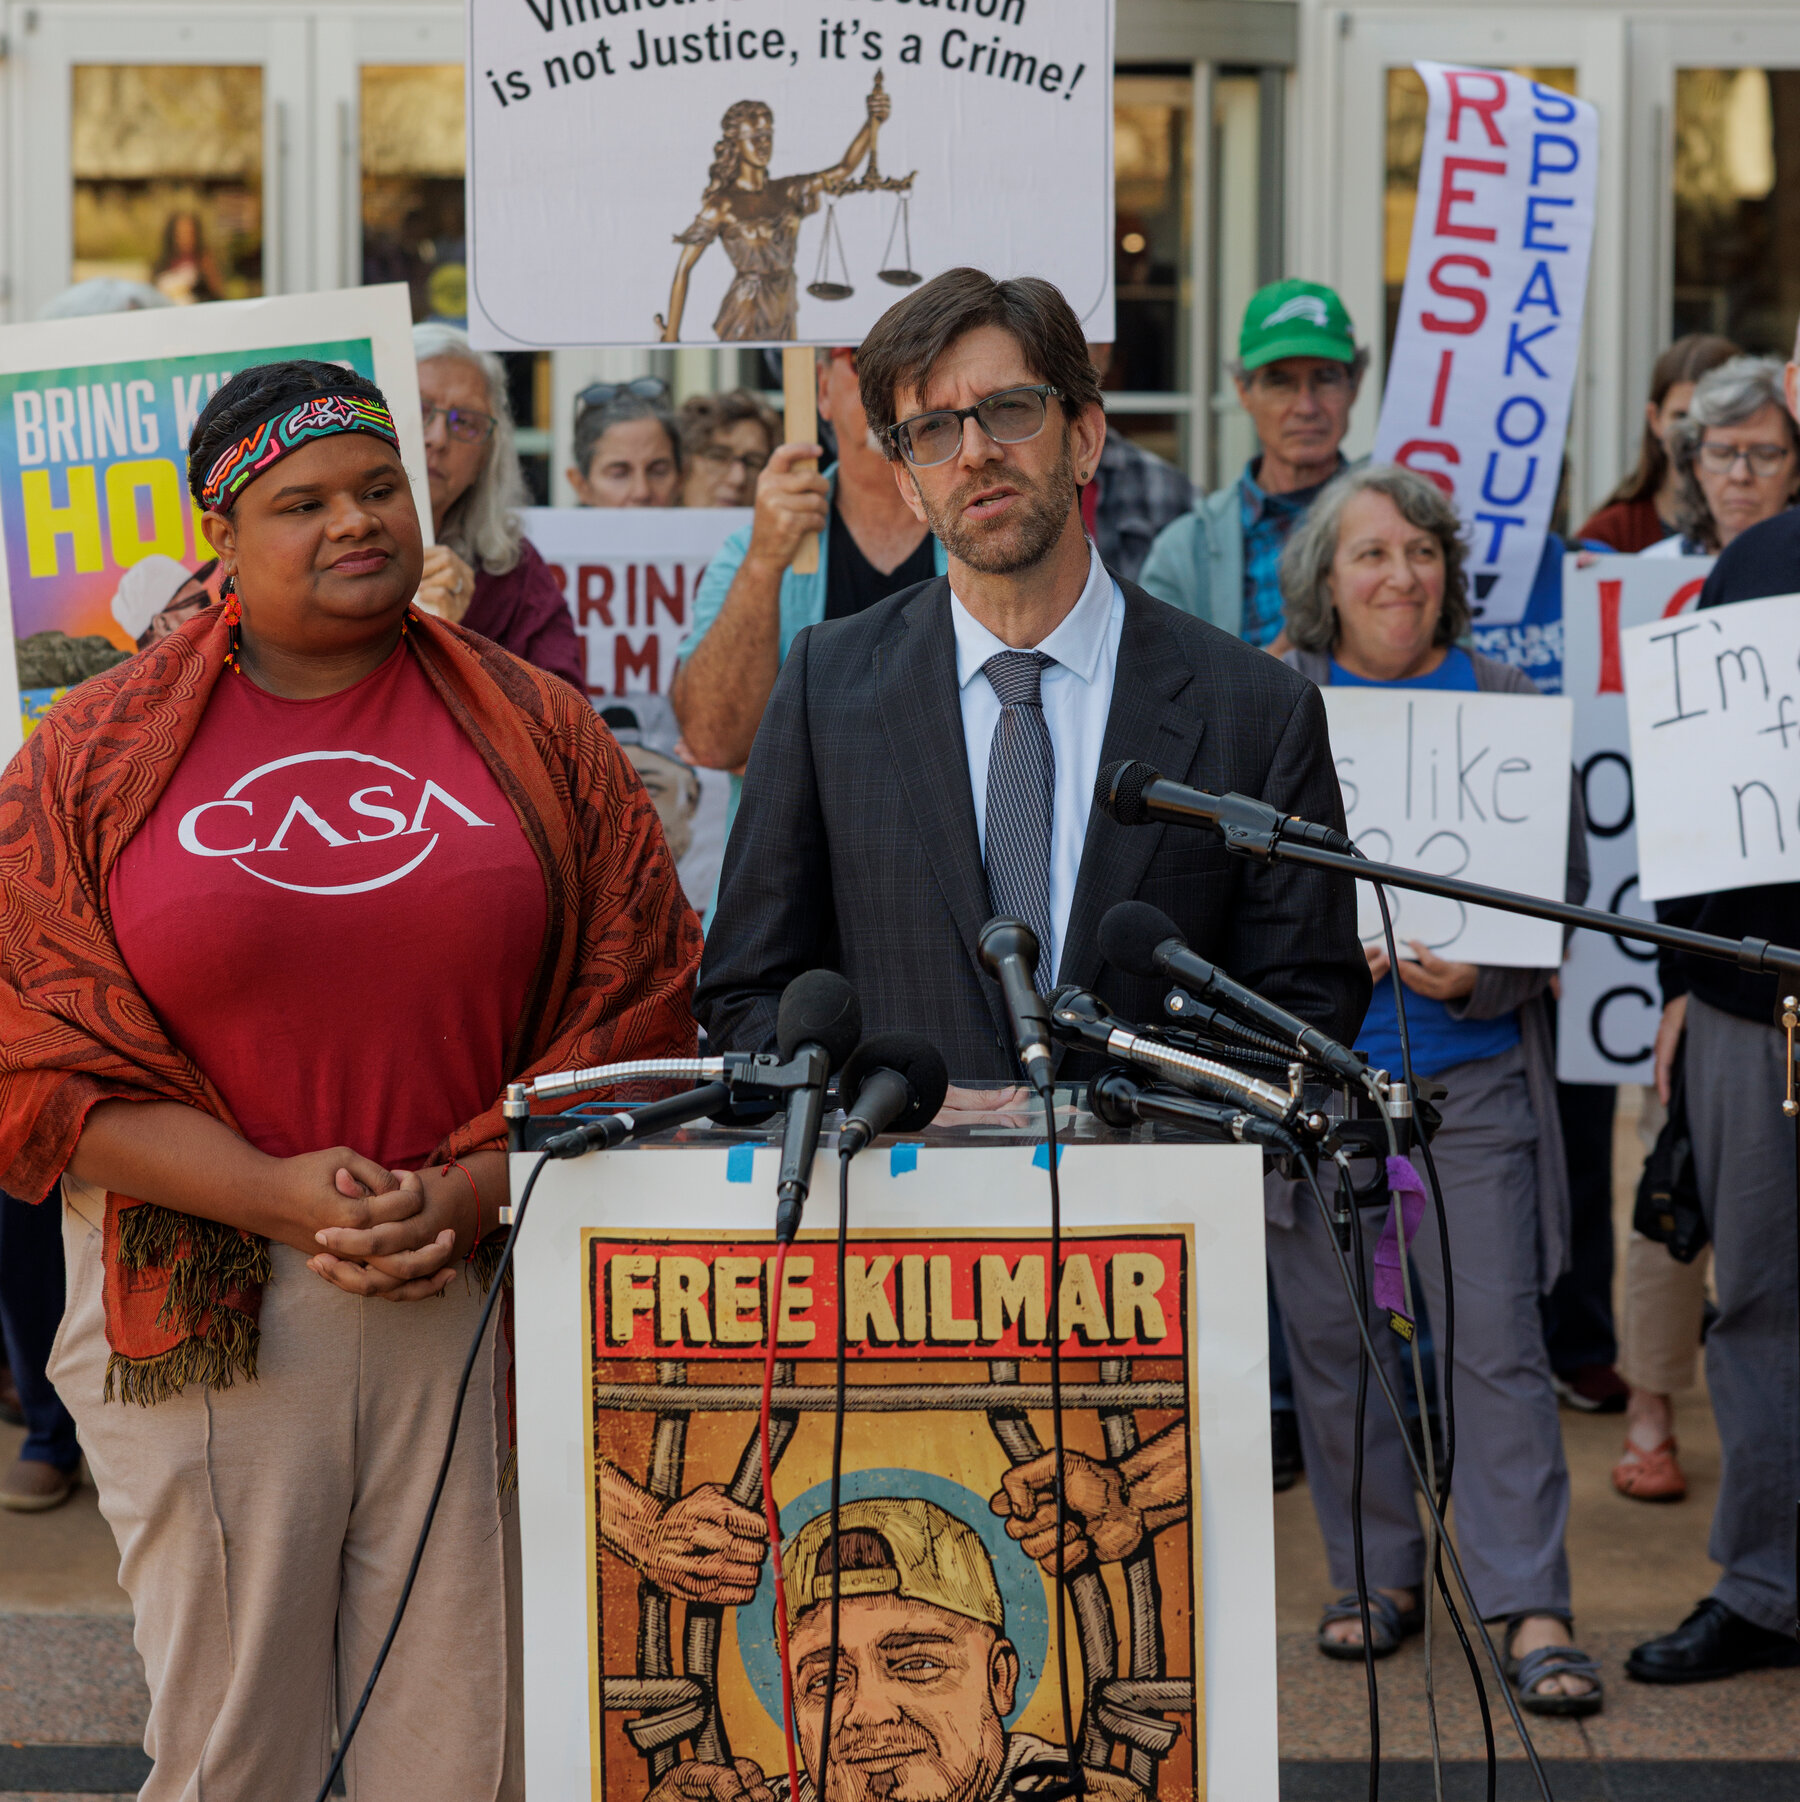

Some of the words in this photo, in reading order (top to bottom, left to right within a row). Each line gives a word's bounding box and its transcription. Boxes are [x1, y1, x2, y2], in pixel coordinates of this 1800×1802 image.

[486, 69, 532, 108] is
[543, 38, 615, 88] not
[629, 19, 799, 70] Justice,
[819, 18, 883, 61] it's
[899, 34, 922, 64] a
[940, 28, 1086, 101] Crime!
[1394, 70, 1508, 498] RESIS
[13, 380, 160, 466] BRING
[549, 564, 707, 627] RIN
[1650, 620, 1769, 729] I'm
[1405, 700, 1531, 823] like
[178, 779, 495, 857] CASA
[604, 1253, 817, 1346] FREE
[841, 1251, 1168, 1347] KILMAR
